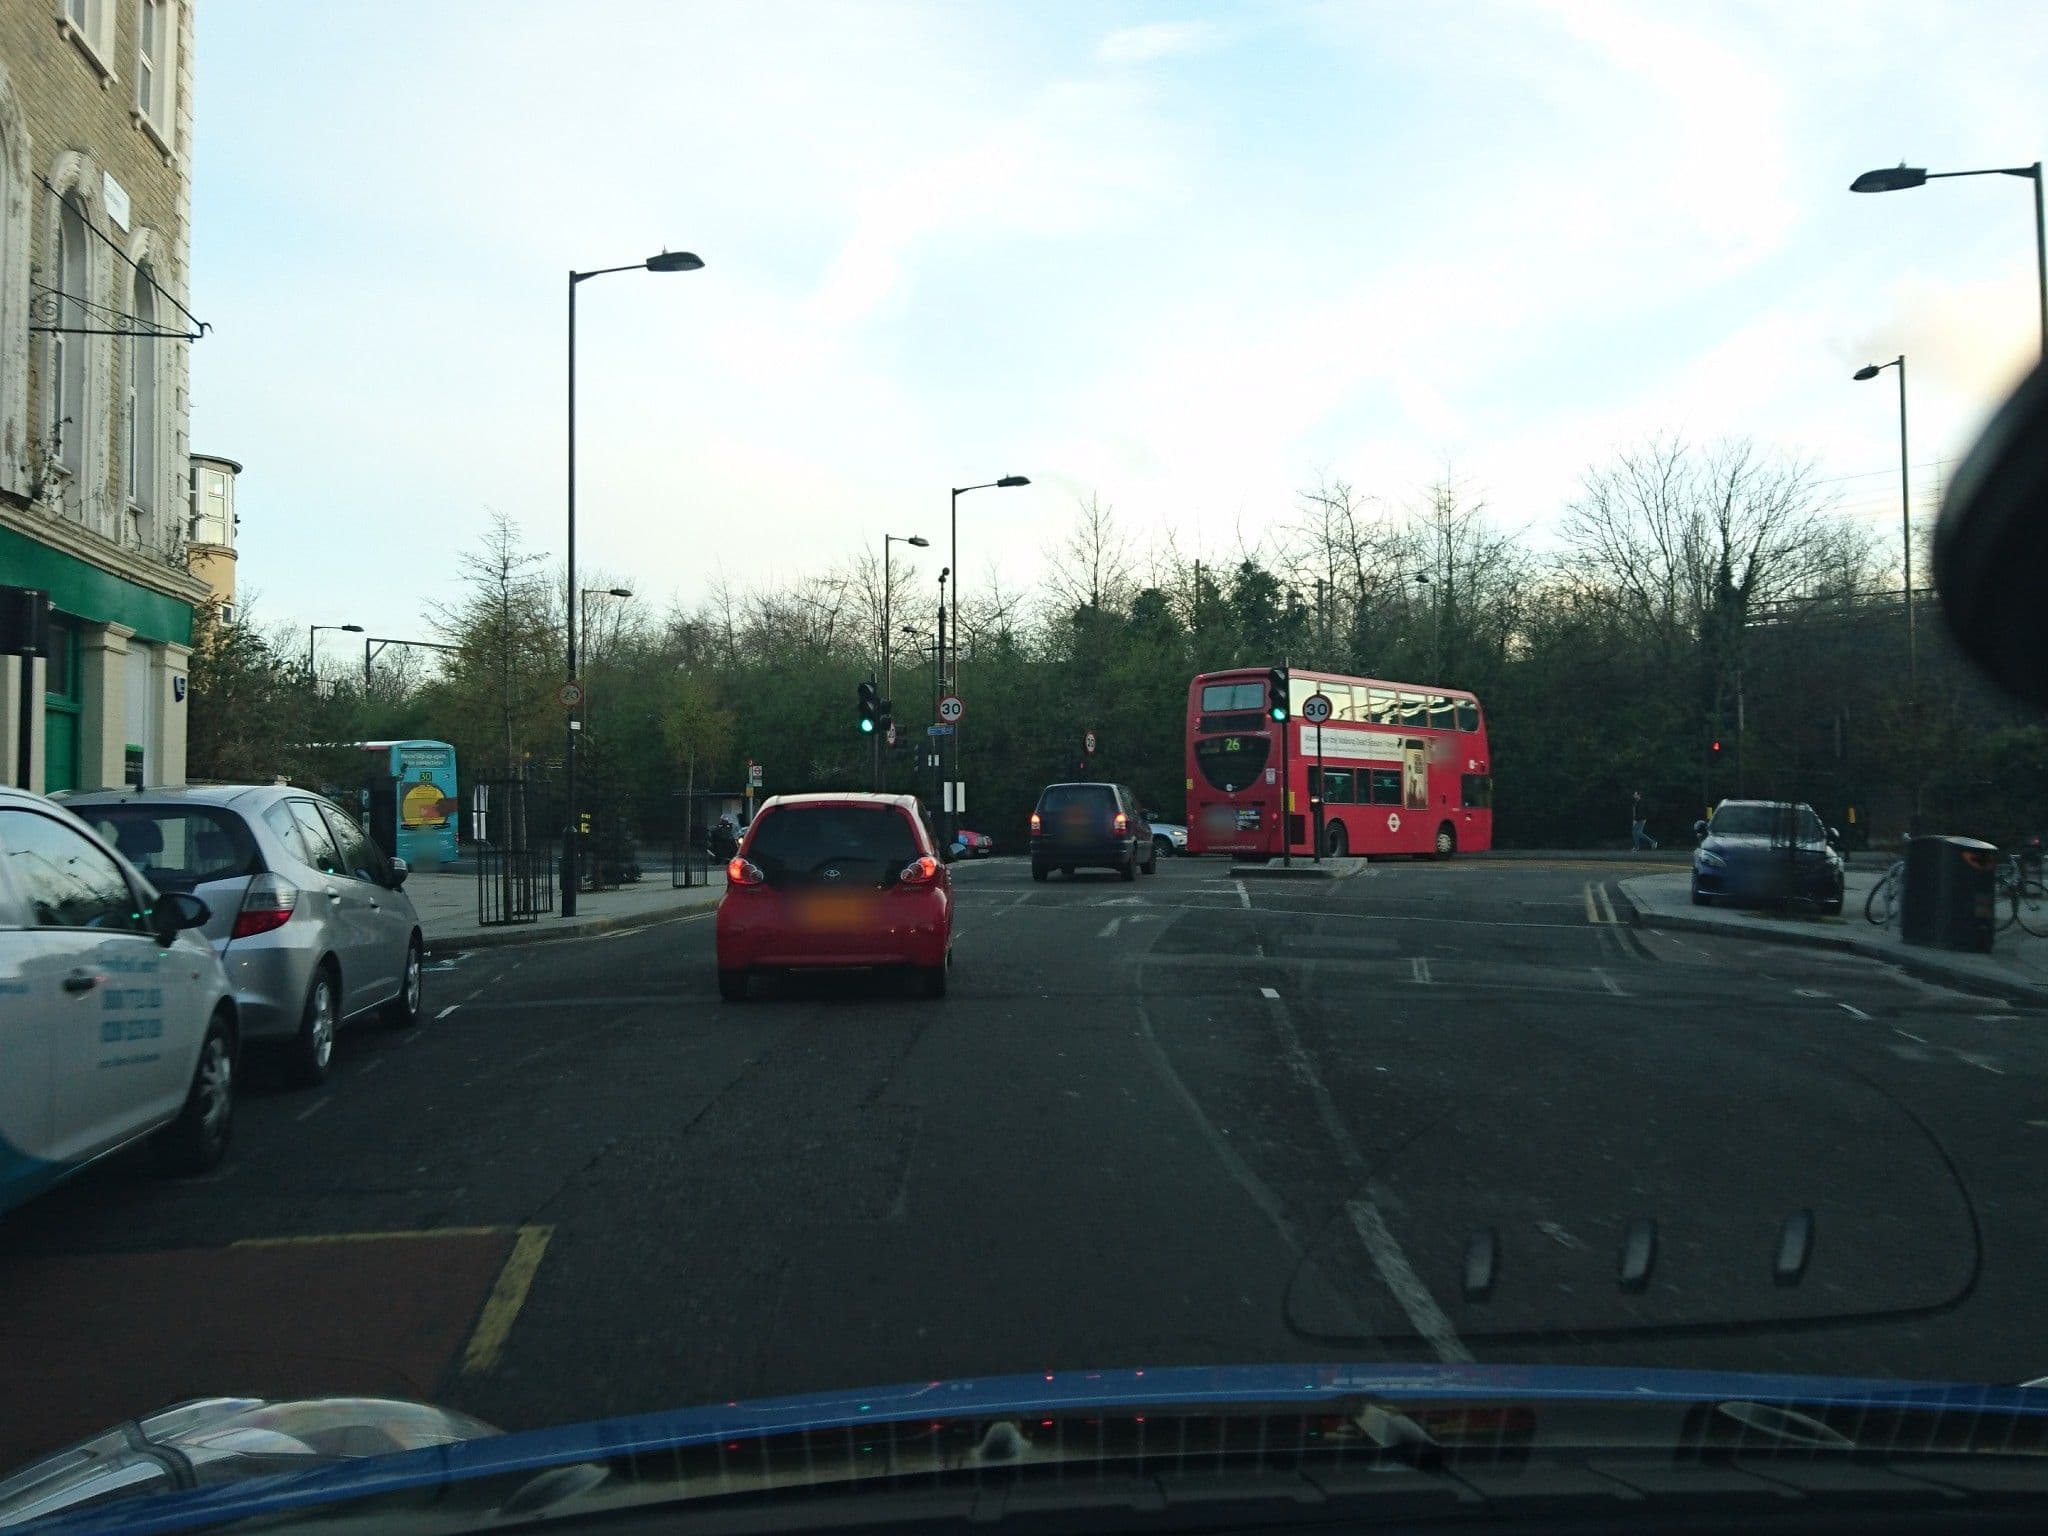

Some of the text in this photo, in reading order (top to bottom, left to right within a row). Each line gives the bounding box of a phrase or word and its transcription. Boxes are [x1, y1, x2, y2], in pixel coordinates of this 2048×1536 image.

[942, 703, 961, 715] 30
[1306, 703, 1328, 716] 30
[1225, 738, 1241, 751] 26
[420, 772, 431, 781] 30
